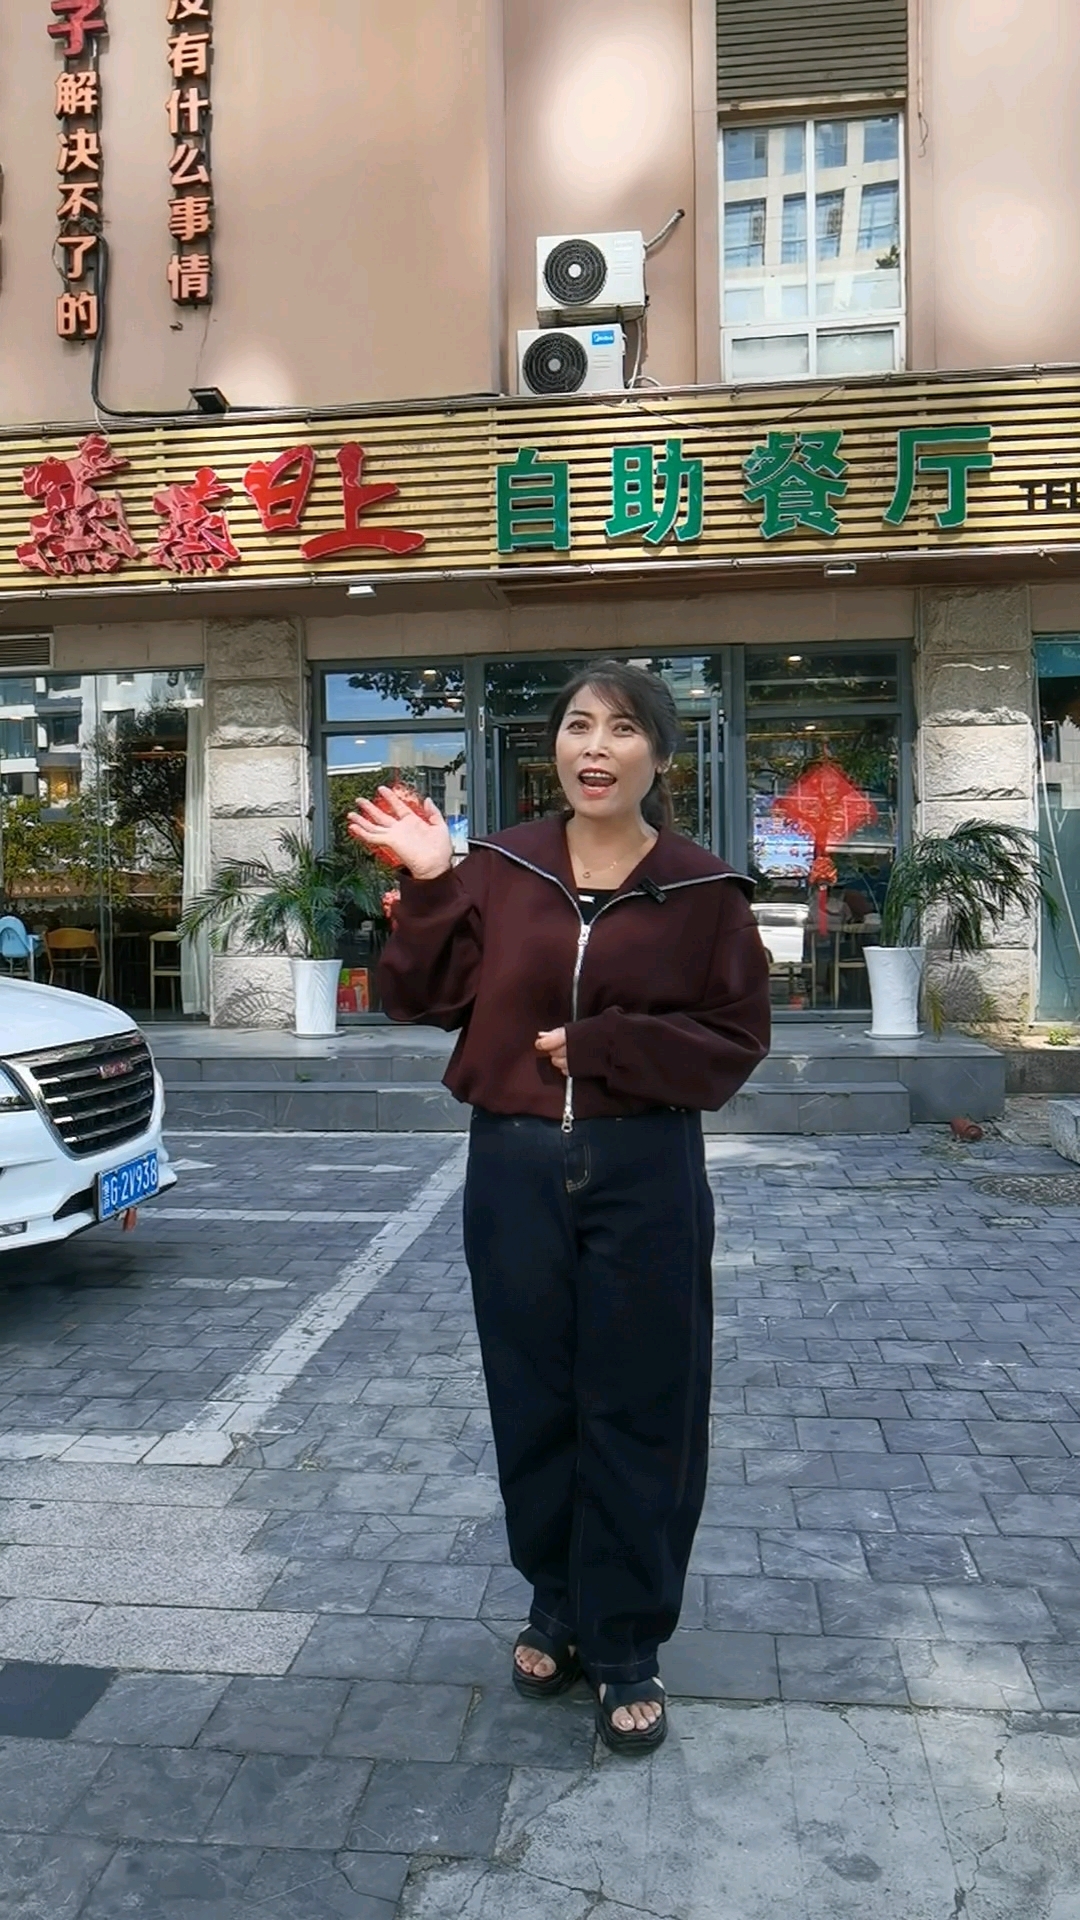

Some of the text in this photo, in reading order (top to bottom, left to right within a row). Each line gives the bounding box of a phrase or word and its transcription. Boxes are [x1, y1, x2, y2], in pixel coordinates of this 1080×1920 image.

[47, 0, 104, 341] 子解决不了的
[15, 425, 994, 577] 蒸蒸日上 自助餐厅
